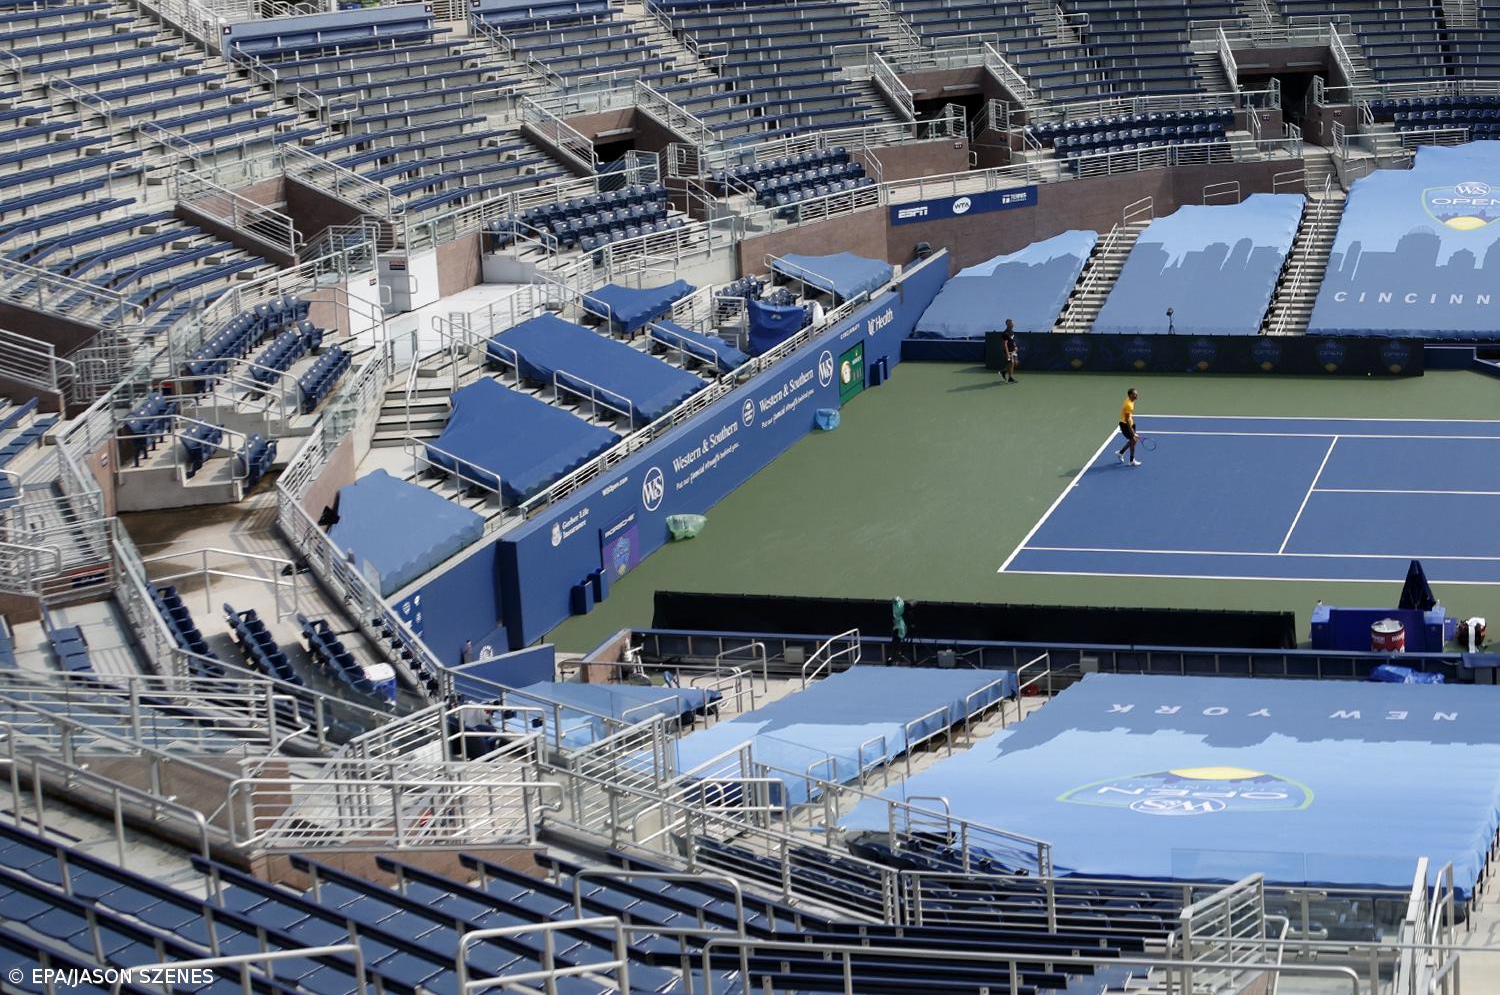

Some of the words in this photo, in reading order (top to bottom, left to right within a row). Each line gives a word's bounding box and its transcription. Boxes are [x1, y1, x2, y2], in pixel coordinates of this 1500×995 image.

[898, 206, 929, 219] ESPN
[954, 202, 970, 210] WTA
[876, 307, 894, 333] Health
[820, 358, 833, 379] W&S
[759, 390, 783, 413] Western
[783, 383, 789, 397] &
[790, 370, 814, 393] Southern
[672, 446, 702, 473] Western
[702, 438, 710, 454] &
[709, 422, 739, 448] Southern
[642, 476, 663, 504] W&S
[562, 514, 580, 530] Gerber
[579, 508, 590, 519] Life
[604, 513, 636, 538] PORSCHE
[562, 520, 587, 540] Insurance
[1106, 703, 1273, 718] YORK
[1330, 710, 1460, 722] NEW
[1097, 786, 1288, 800] OPEN
